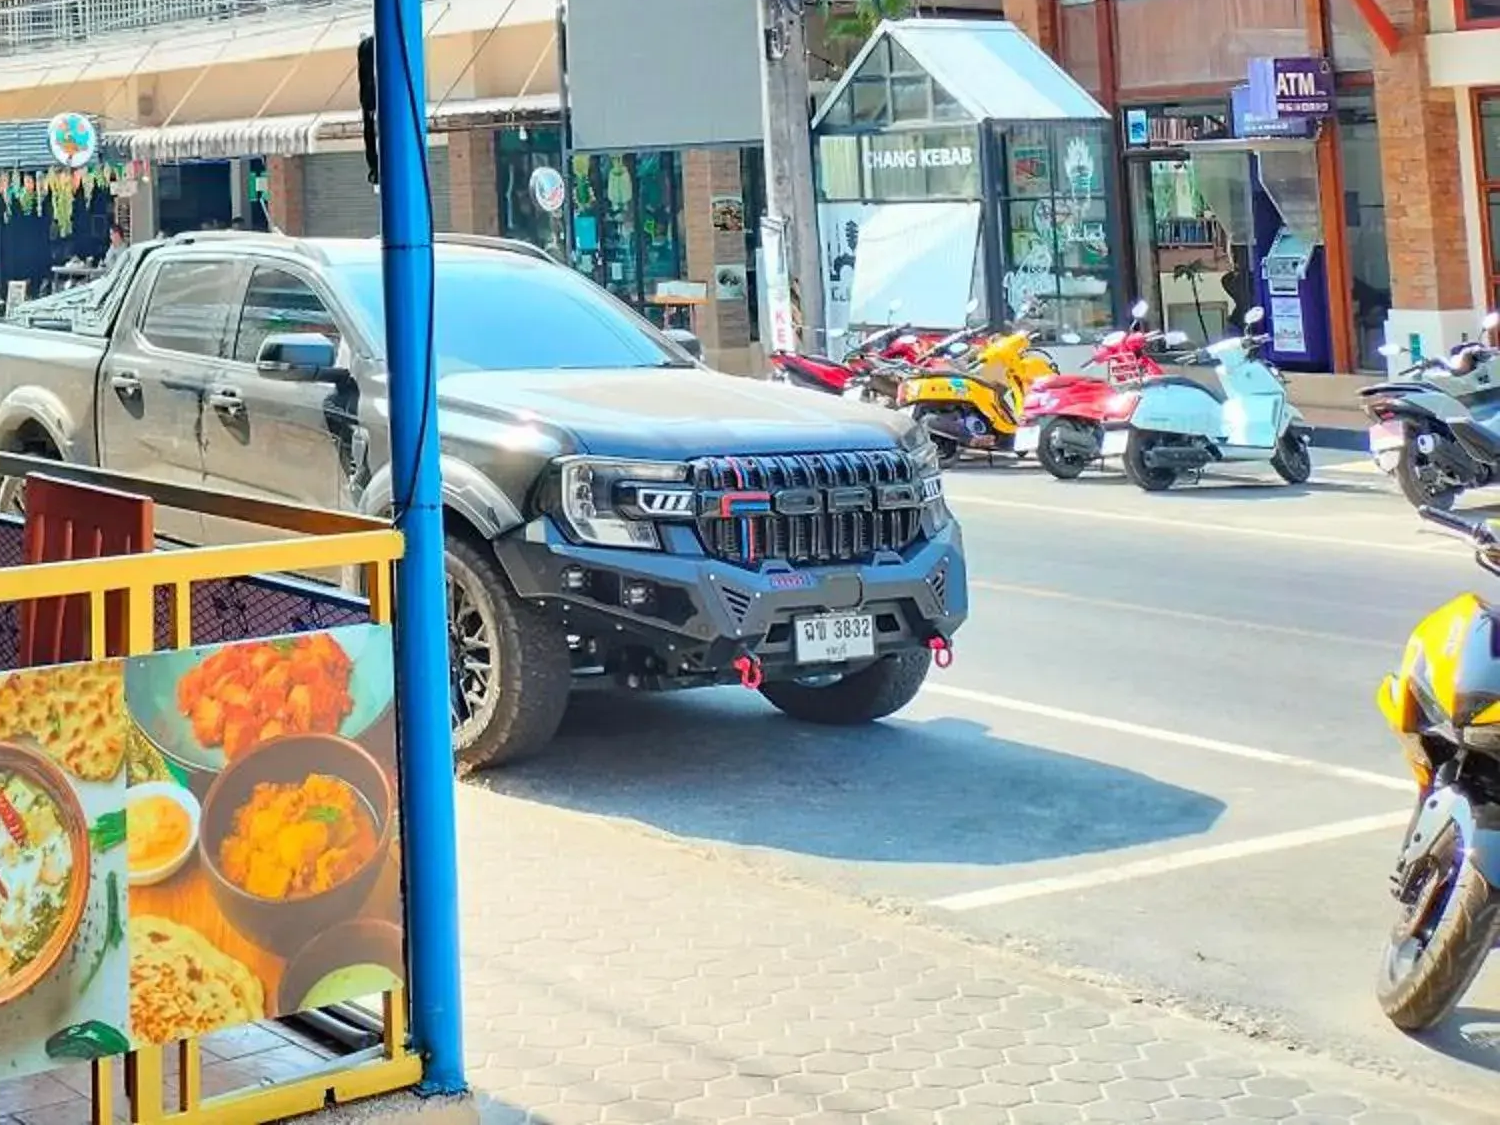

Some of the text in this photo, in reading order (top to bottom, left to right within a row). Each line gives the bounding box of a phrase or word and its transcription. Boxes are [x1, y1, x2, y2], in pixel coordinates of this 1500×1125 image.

[1276, 72, 1315, 96] ATM
[920, 146, 972, 168] KEBAB
[833, 618, 870, 639] 3832
